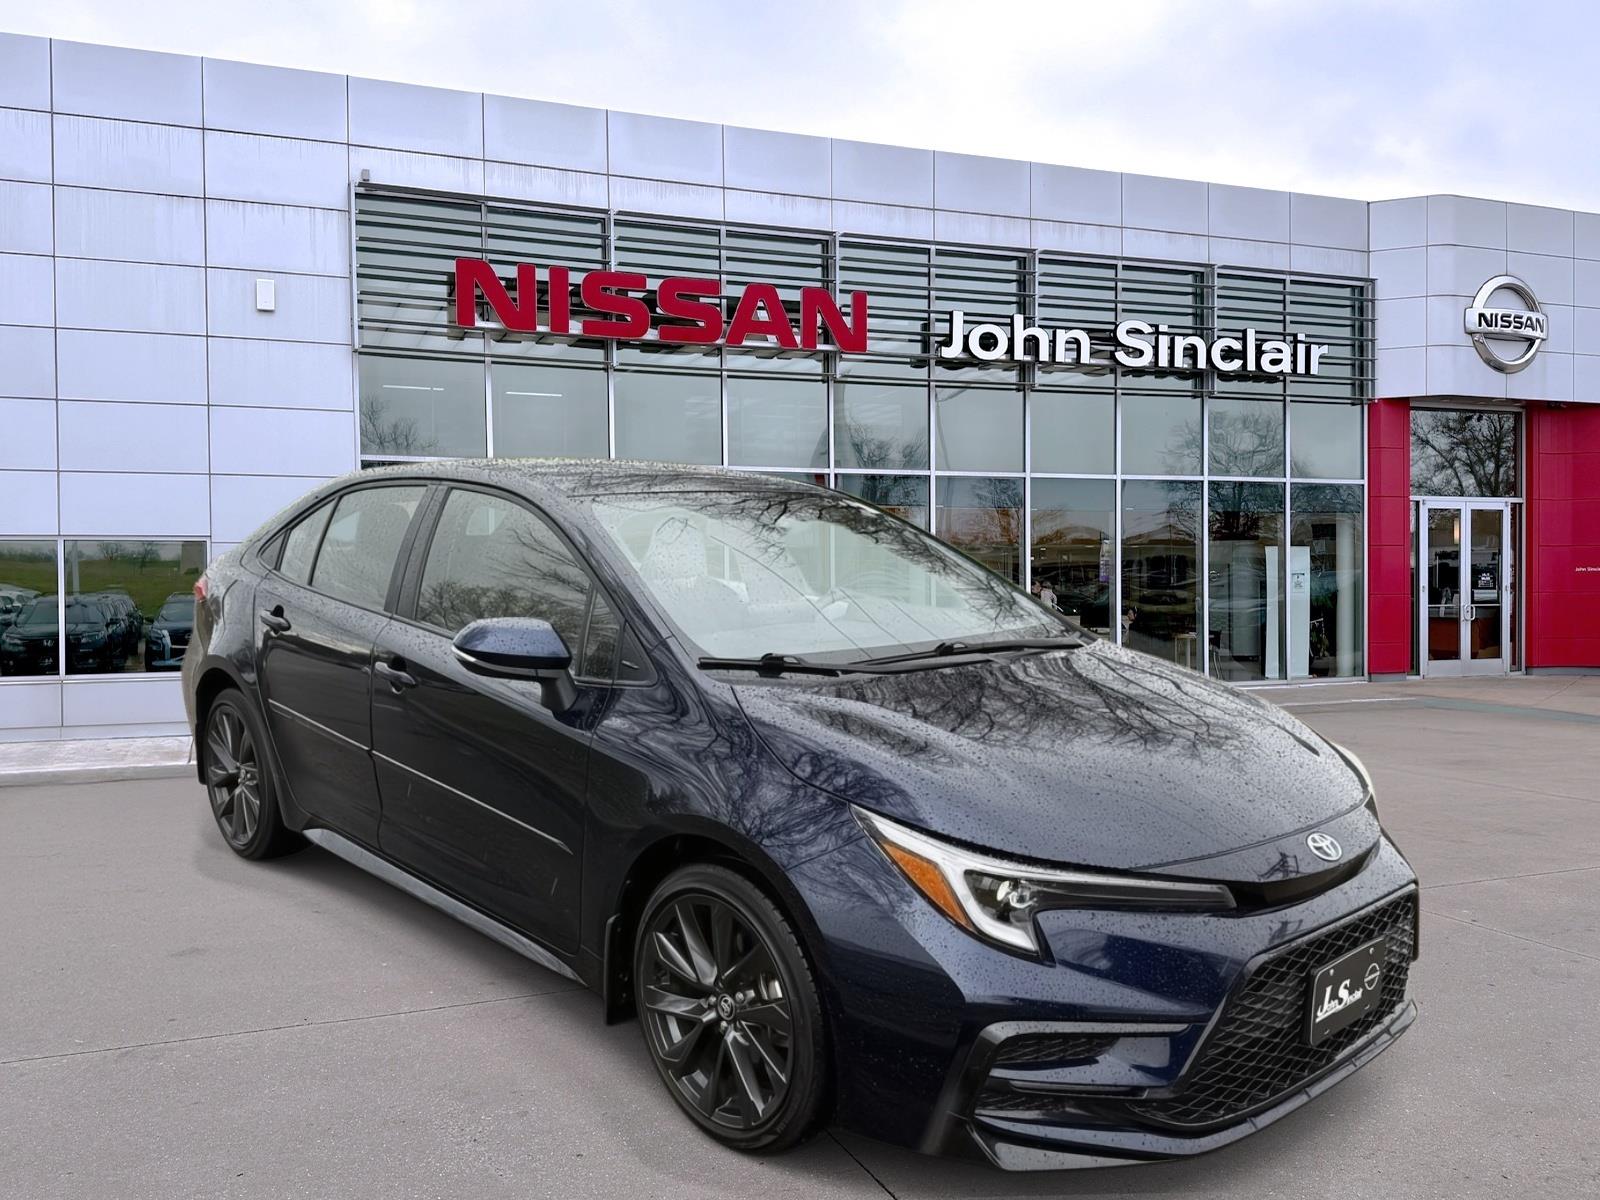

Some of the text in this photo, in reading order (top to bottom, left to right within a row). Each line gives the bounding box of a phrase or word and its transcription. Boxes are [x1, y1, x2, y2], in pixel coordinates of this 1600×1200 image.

[455, 257, 868, 353] NISSAN
[1478, 312, 1544, 333] NISSAN
[941, 310, 1328, 375] John Sinclair
